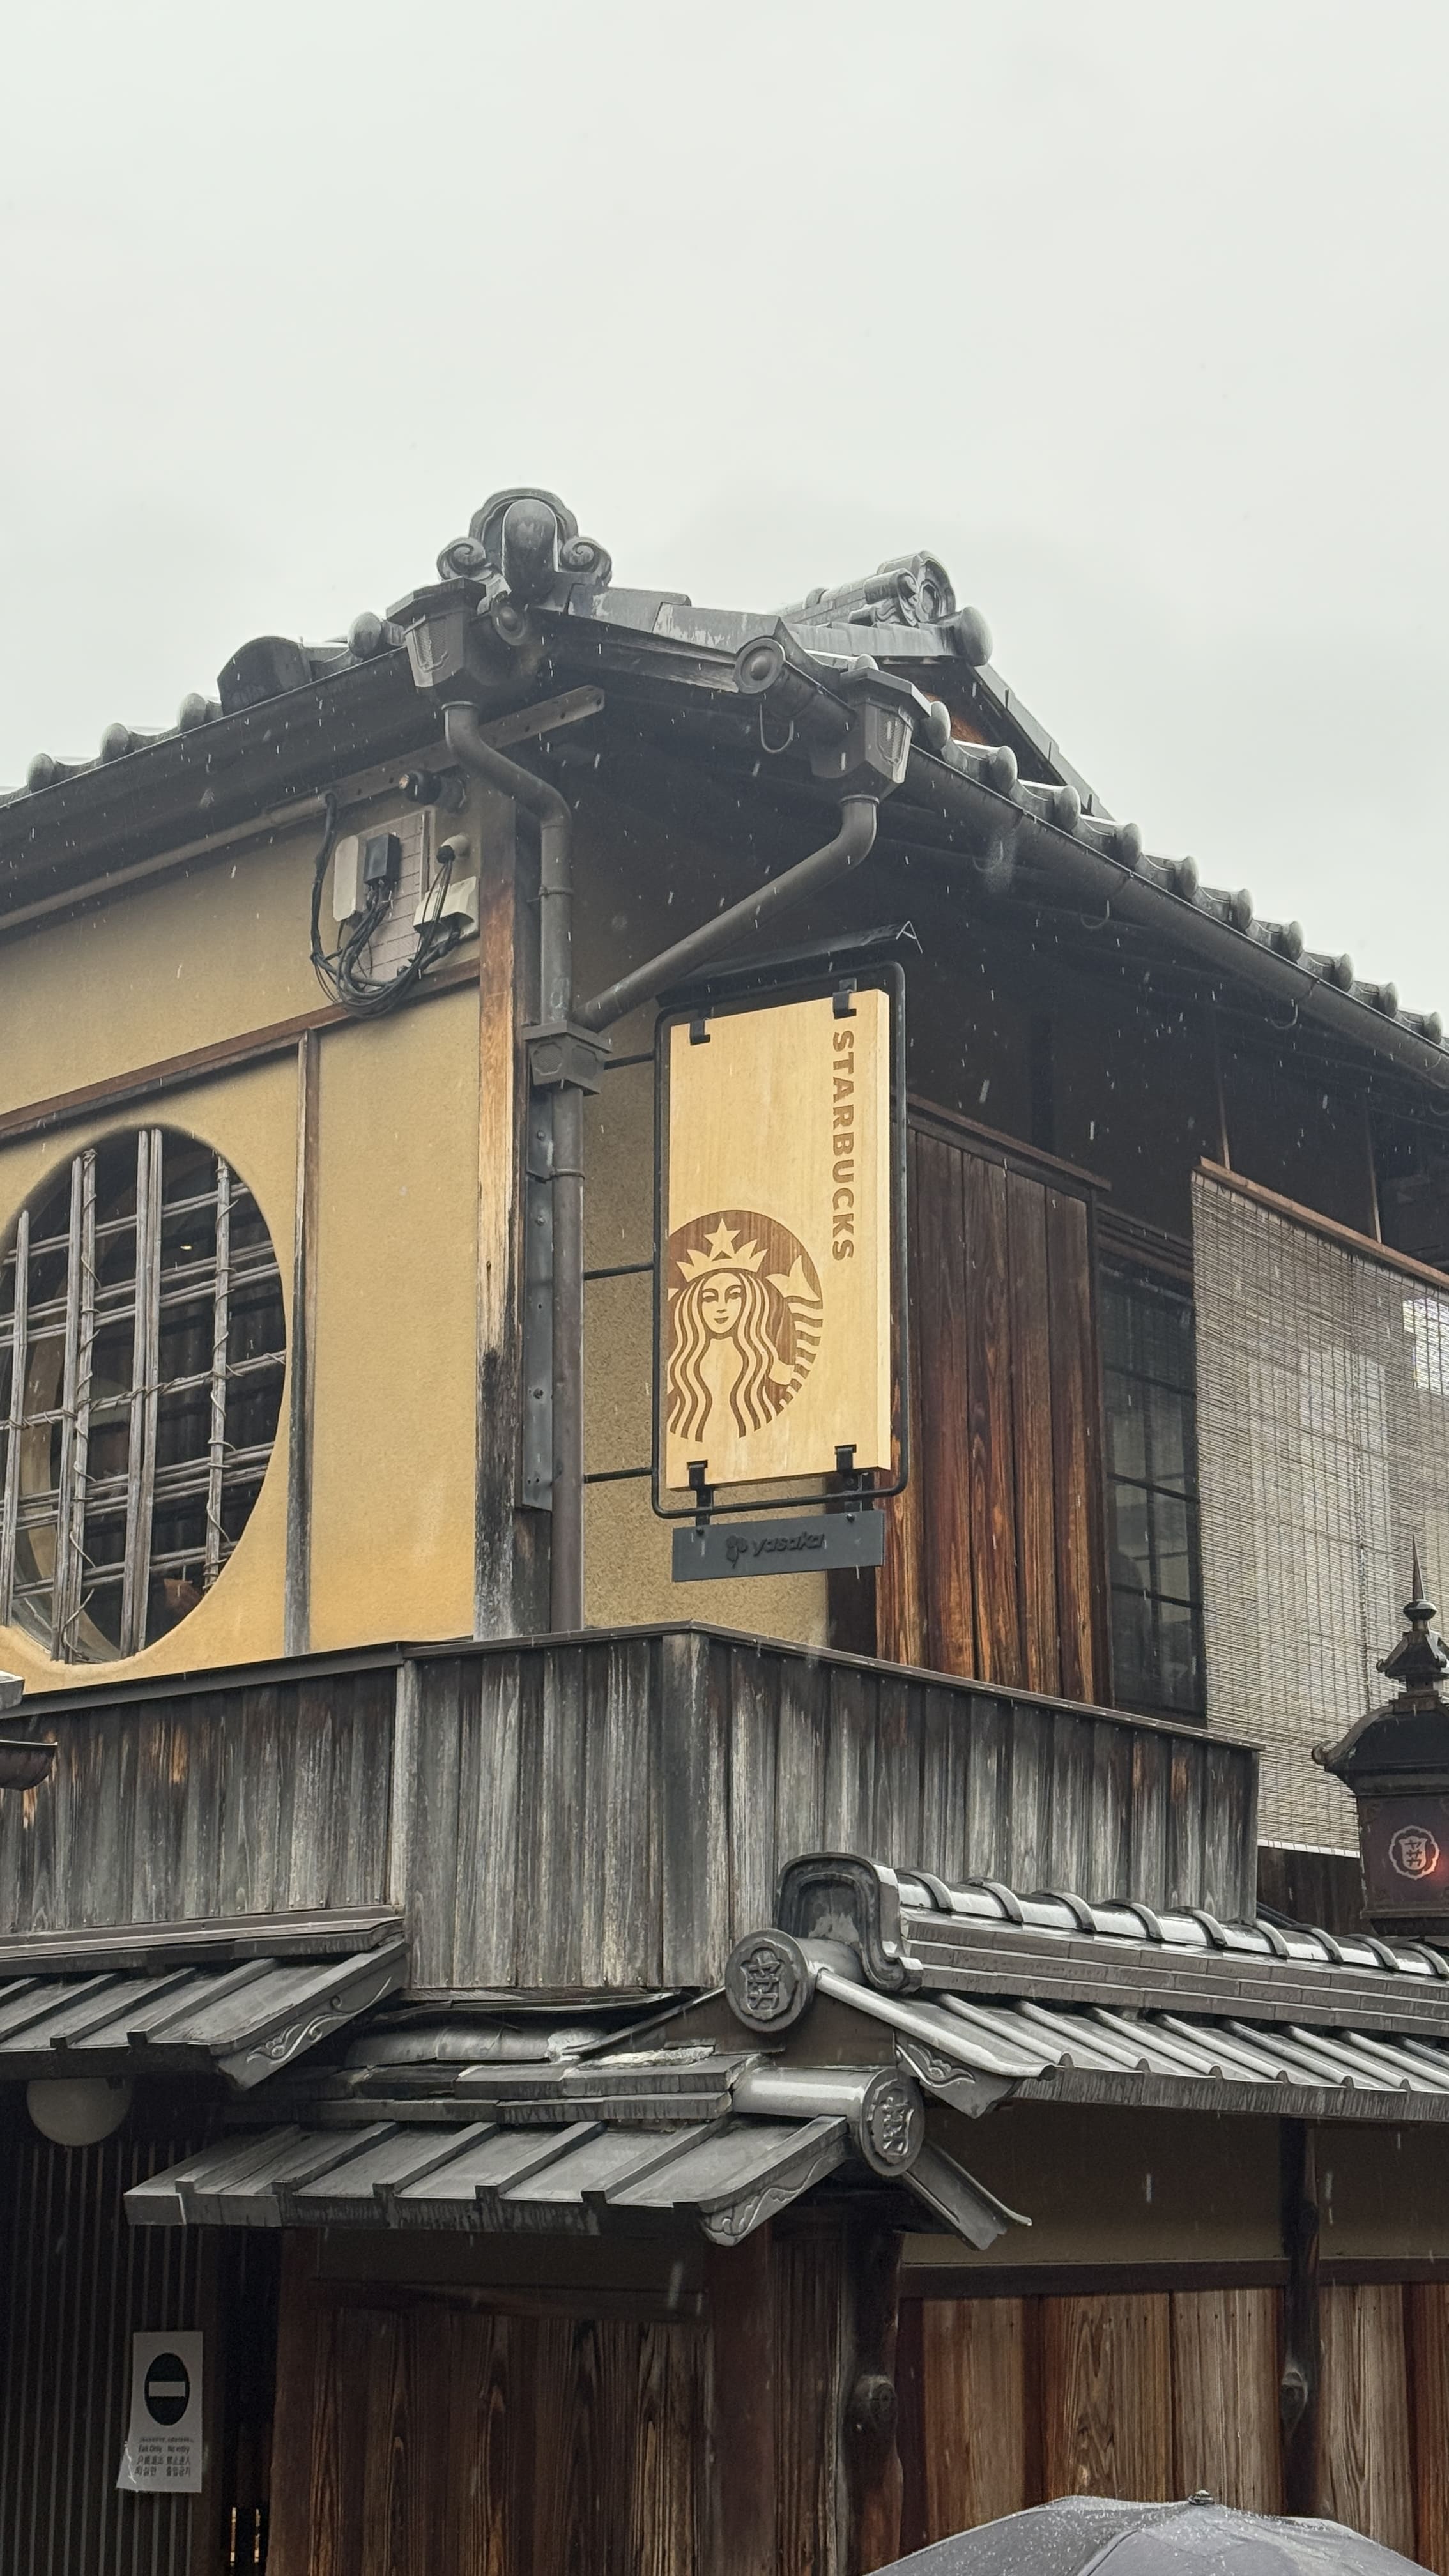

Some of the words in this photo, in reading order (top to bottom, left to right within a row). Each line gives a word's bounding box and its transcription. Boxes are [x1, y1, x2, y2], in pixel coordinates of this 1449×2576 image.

[832, 1030, 854, 1261] STARBUCKS
[753, 1531, 825, 1557] yasaka
[1405, 1838, 1422, 1867] ヤサカ
[748, 1957, 781, 2009] ヤサカ
